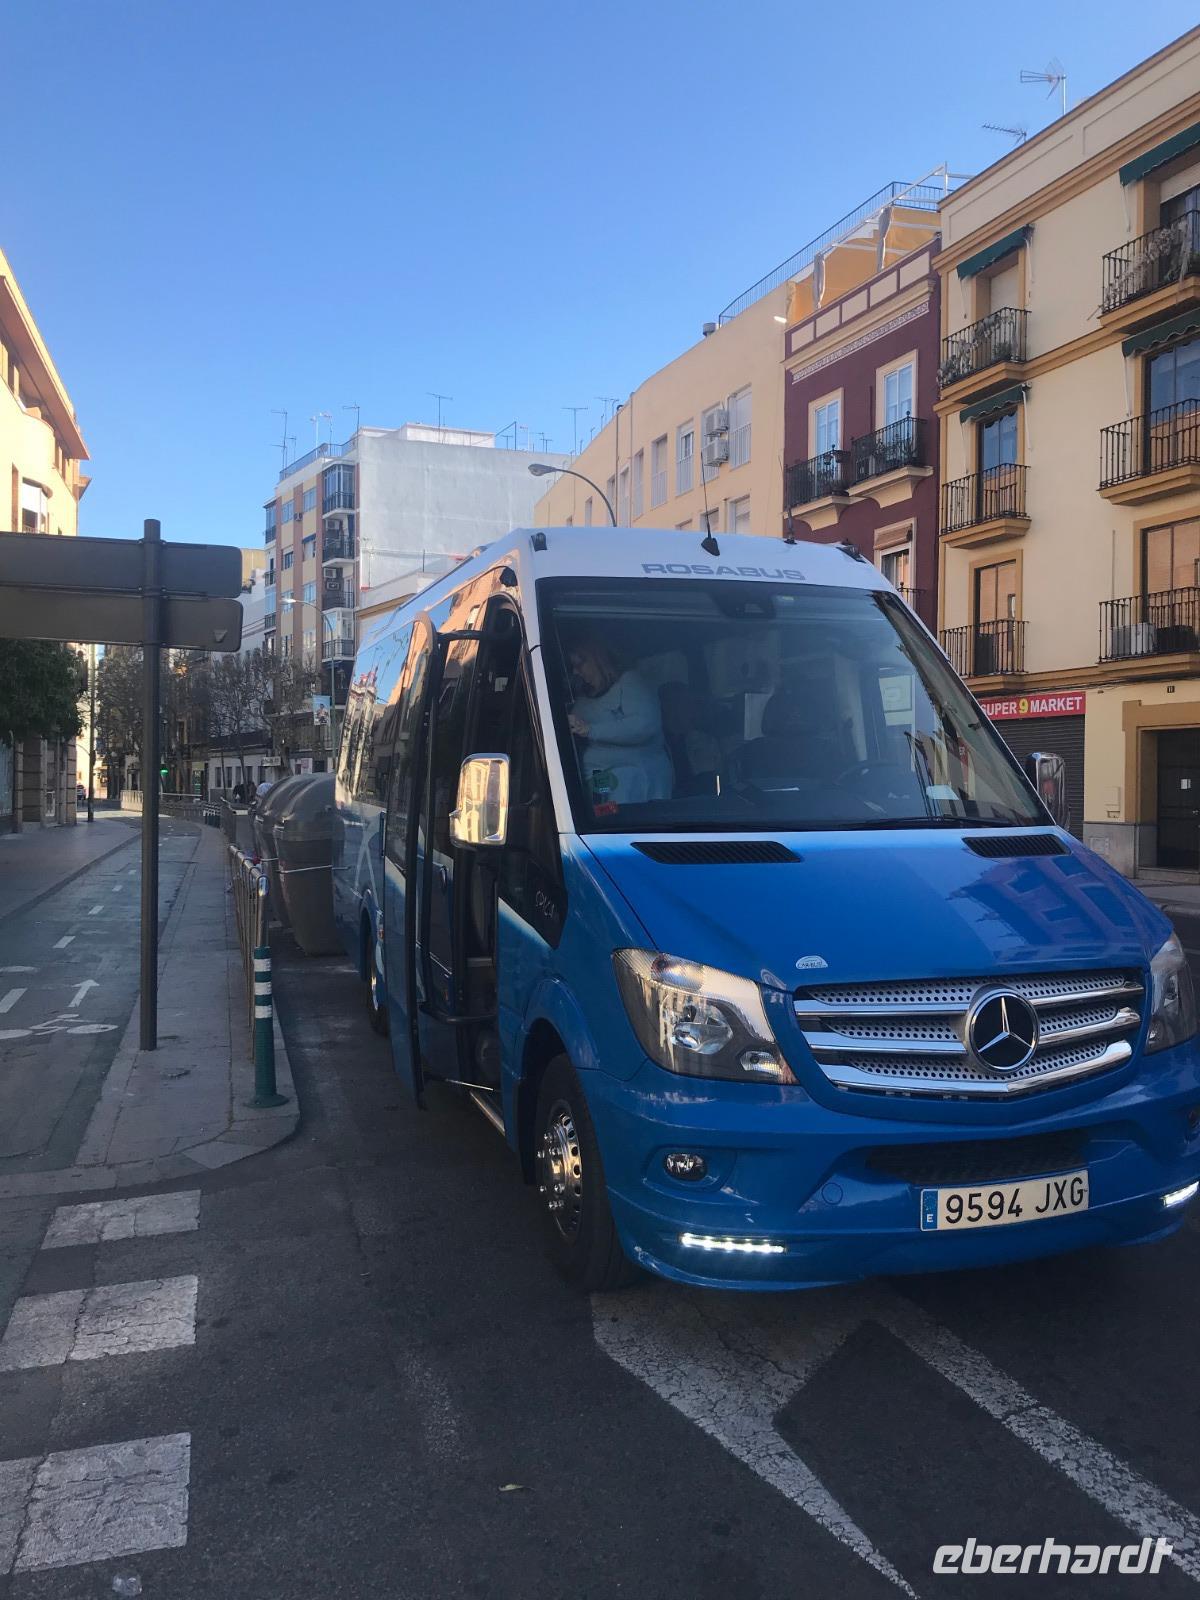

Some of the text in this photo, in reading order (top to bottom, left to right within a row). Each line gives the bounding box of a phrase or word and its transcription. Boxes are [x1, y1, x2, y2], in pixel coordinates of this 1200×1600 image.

[641, 563, 806, 580] ROSABUS
[1019, 698, 1028, 714] 9
[1030, 696, 1083, 713] MARKET
[926, 1176, 1084, 1224] E 9594 JXG
